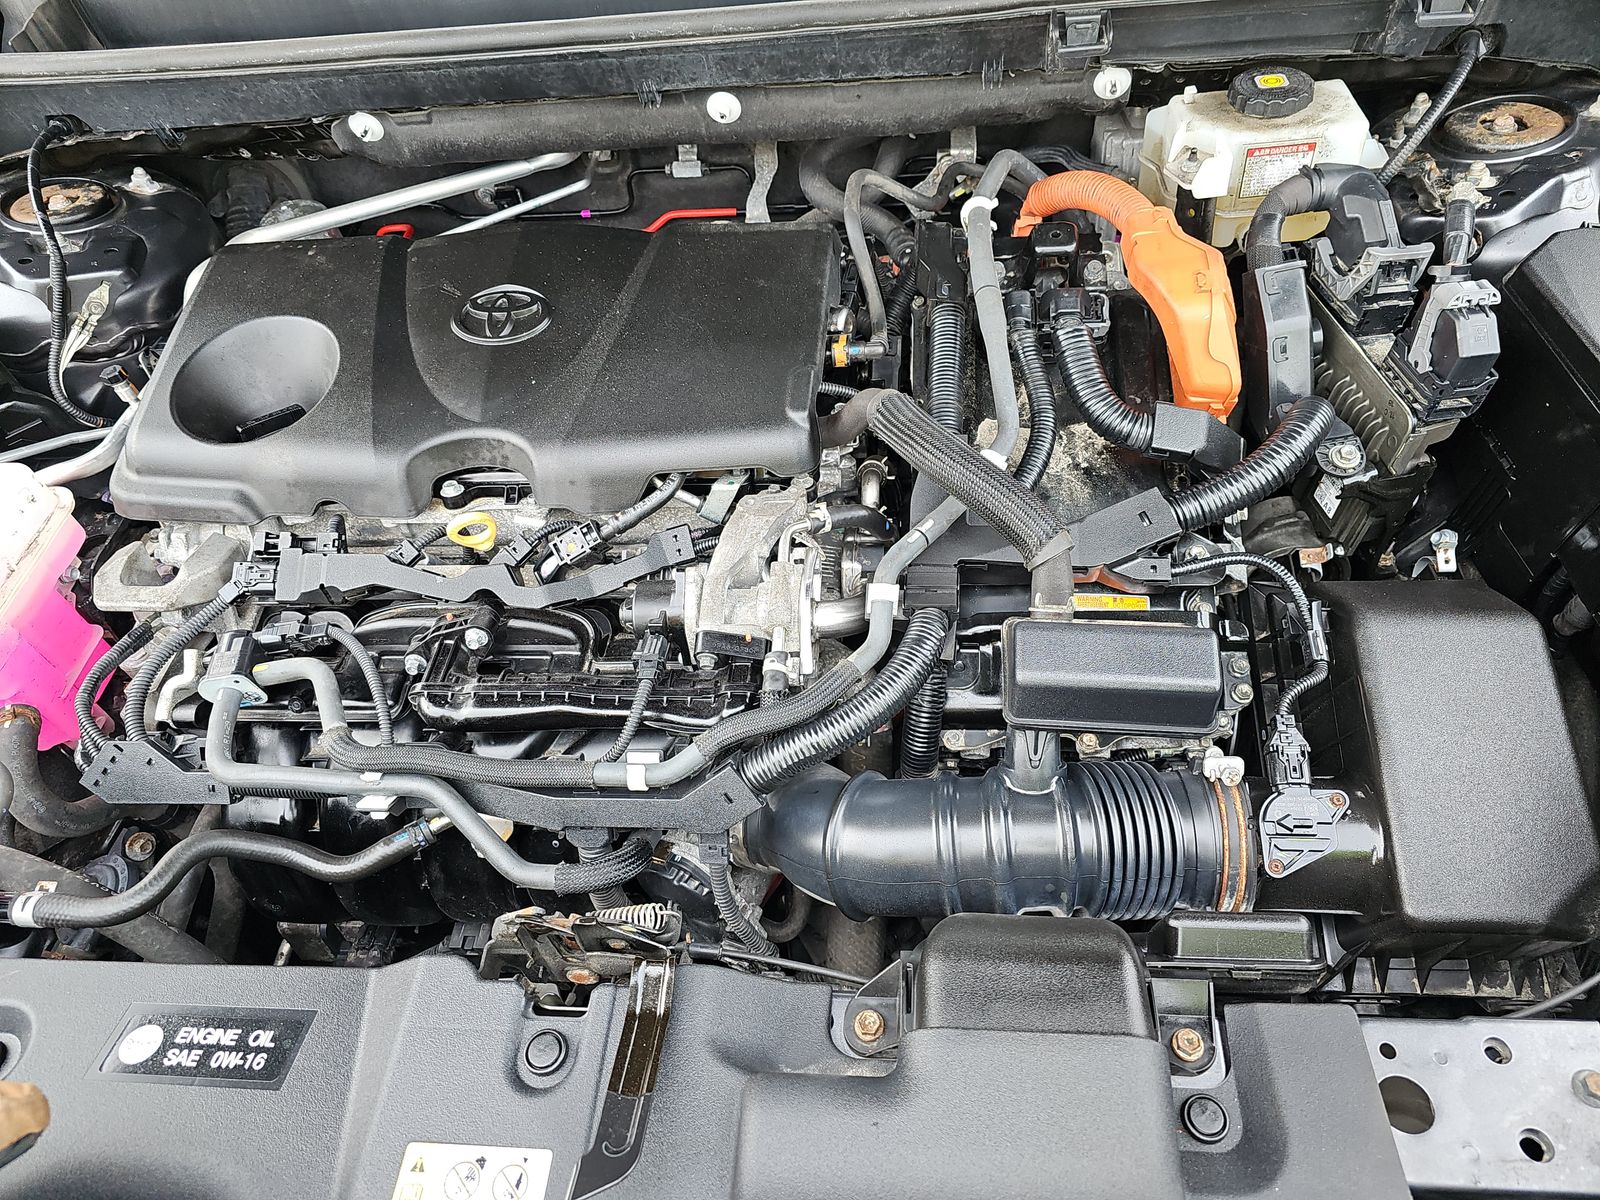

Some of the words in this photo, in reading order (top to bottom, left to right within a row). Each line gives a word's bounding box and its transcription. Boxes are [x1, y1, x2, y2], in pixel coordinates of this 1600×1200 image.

[173, 1026, 242, 1046] ENGINE
[248, 1029, 275, 1048] OIL
[163, 1049, 203, 1067] SAE
[210, 1051, 268, 1071] 0W-16
